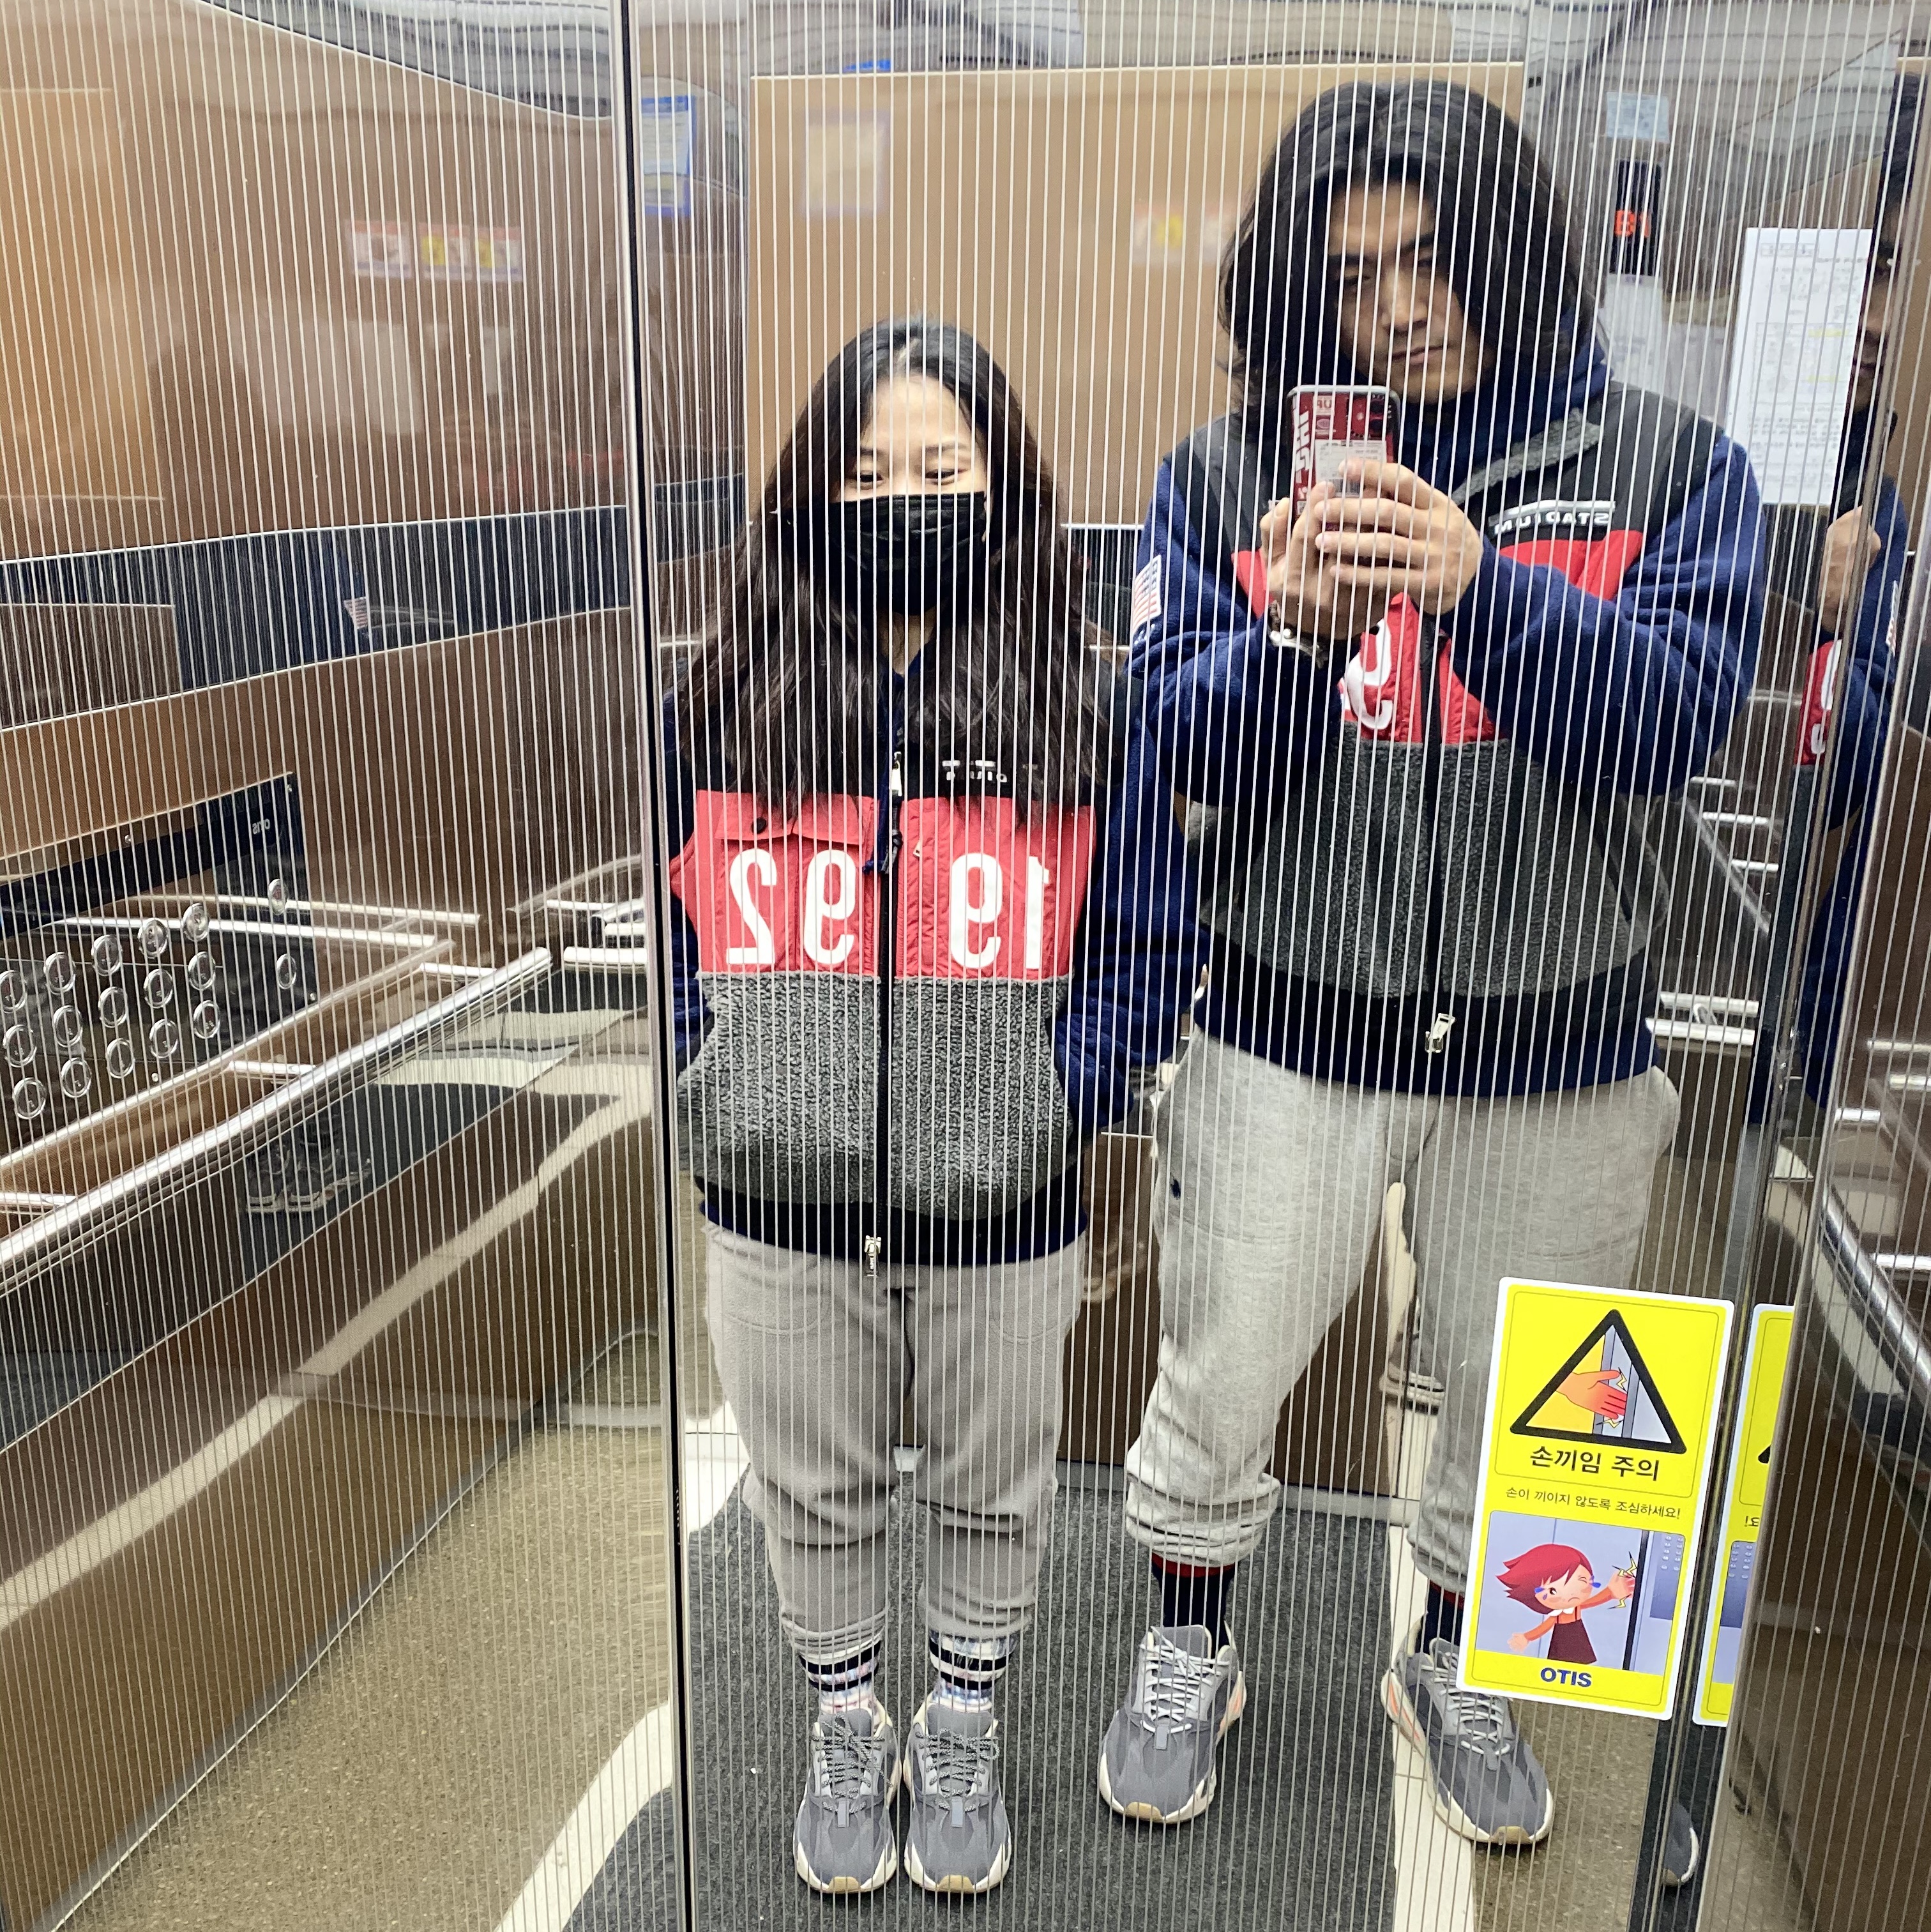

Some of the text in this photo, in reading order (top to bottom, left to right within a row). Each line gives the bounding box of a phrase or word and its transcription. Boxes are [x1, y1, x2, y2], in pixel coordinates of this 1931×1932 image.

[1614, 209, 1651, 238] B1
[1530, 1445, 1660, 1481] 손끼임 주의
[1506, 1487, 1681, 1519] 손이 끼이지 않도록 조심하세요!
[1540, 1667, 1592, 1687] OTIS
